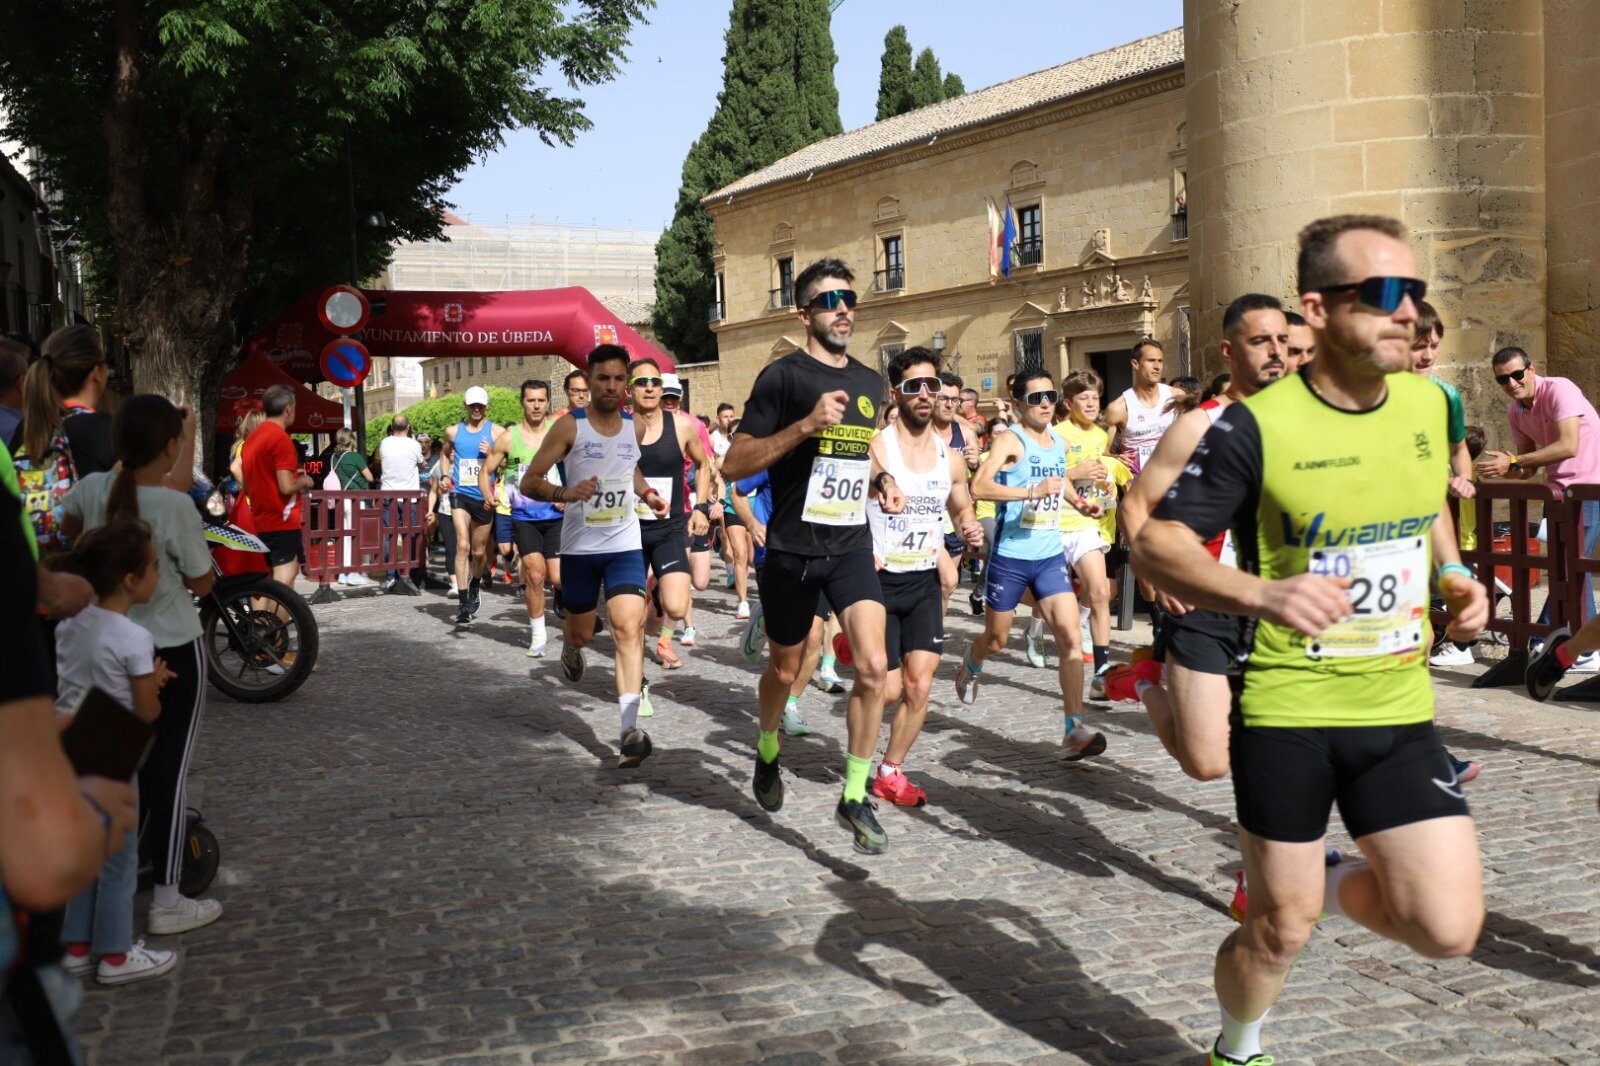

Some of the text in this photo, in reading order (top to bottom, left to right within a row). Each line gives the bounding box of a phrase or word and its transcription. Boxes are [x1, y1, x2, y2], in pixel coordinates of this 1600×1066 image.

[477, 332, 498, 343] DE
[502, 329, 554, 344] ÚBEDA
[835, 441, 867, 454] OVIEDO
[813, 462, 836, 478] 40
[820, 478, 864, 501] 506
[594, 489, 627, 509] 797
[887, 519, 907, 532] 40
[902, 531, 929, 551] 47
[1349, 573, 1398, 614] 28
